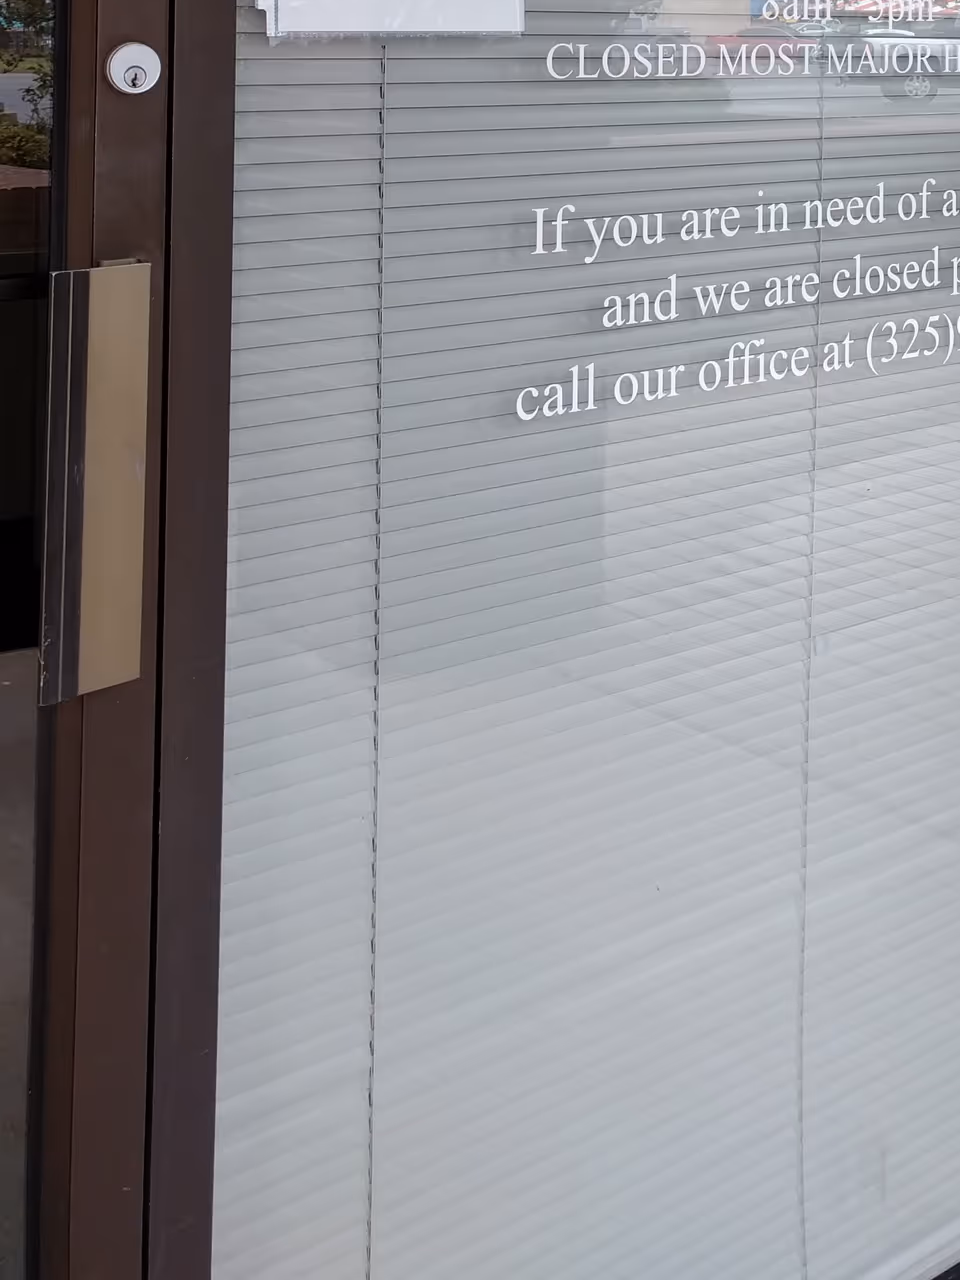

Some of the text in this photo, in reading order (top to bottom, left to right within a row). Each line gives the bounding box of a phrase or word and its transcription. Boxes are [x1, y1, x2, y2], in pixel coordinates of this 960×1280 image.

[545, 42, 706, 80] CLOSED
[716, 42, 820, 77] MOST
[826, 42, 936, 75] MAJOR
[531, 204, 575, 255] If
[584, 214, 664, 264] you
[680, 205, 741, 242] are
[754, 190, 790, 235] in
[803, 182, 885, 230] need
[898, 178, 936, 221] of
[602, 274, 679, 328] and
[692, 278, 751, 317] we
[763, 266, 820, 308] are
[832, 246, 941, 300] closed
[515, 362, 598, 421] call
[613, 361, 685, 406] our
[698, 337, 810, 393] office
[823, 332, 855, 373] at
